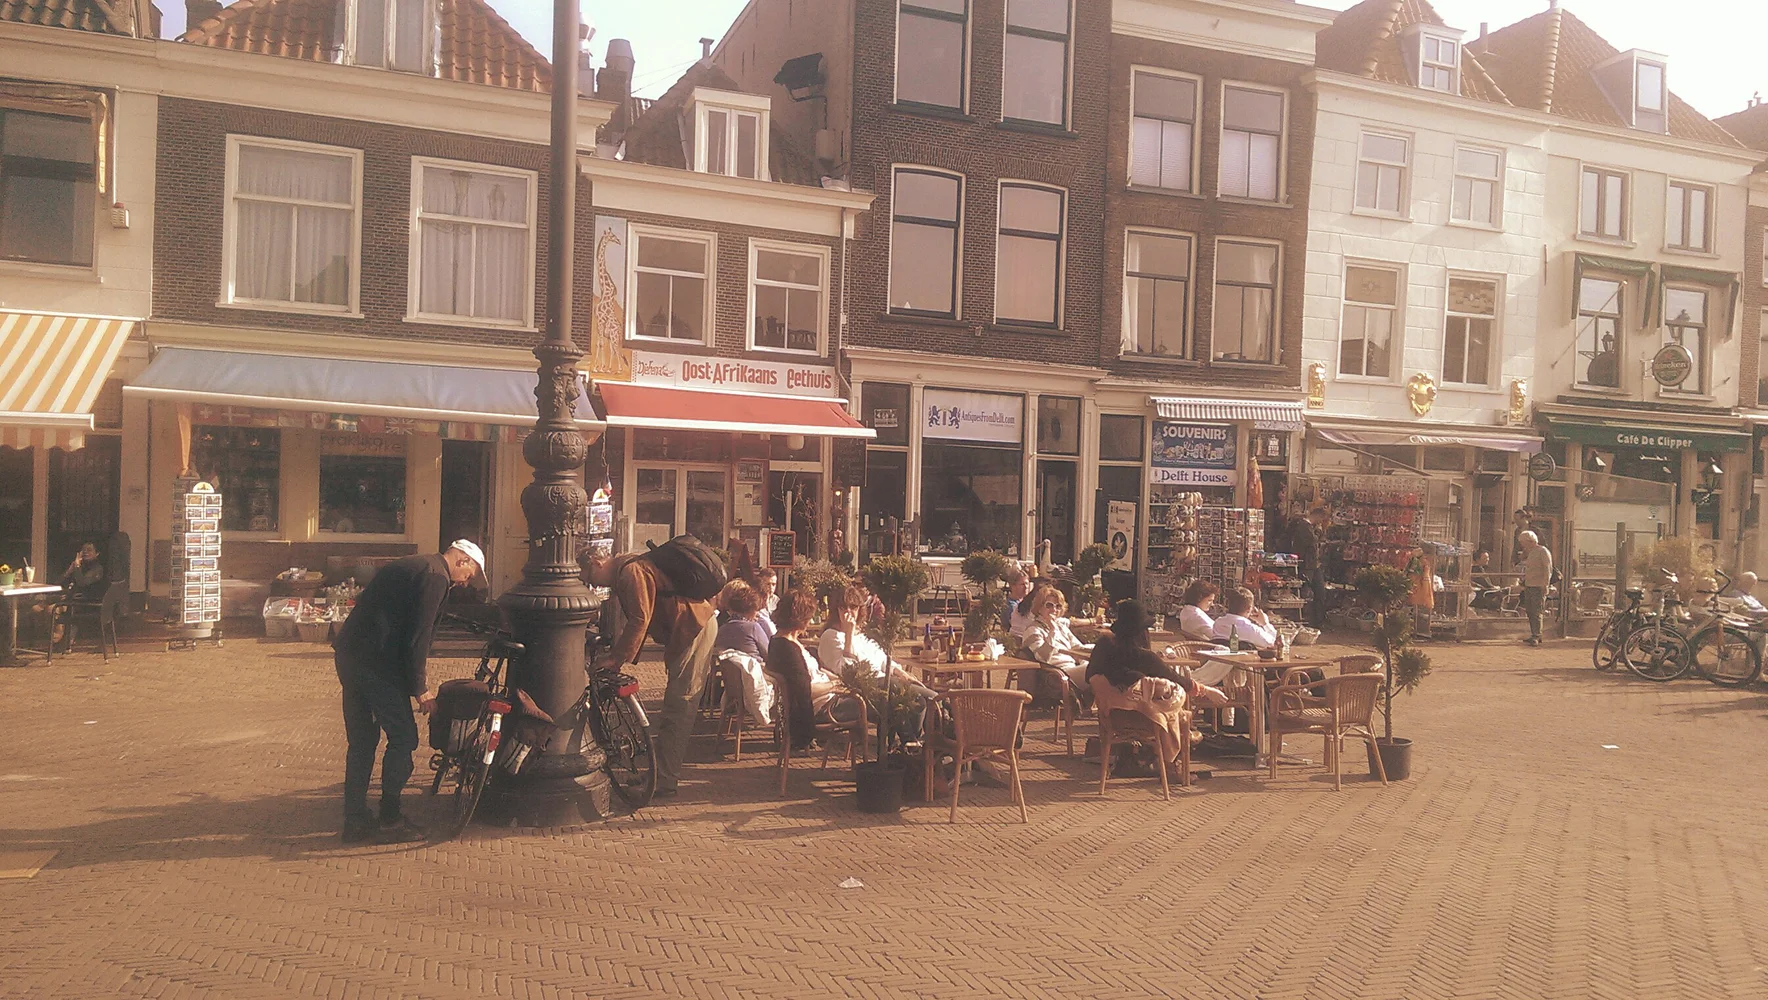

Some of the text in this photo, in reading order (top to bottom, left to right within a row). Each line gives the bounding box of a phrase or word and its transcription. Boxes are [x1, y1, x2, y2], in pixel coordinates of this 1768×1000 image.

[1162, 425, 1227, 440] SOUVENIRS
[1616, 433, 1693, 449] Café De Clipper
[1161, 469, 1228, 483] Delft House
